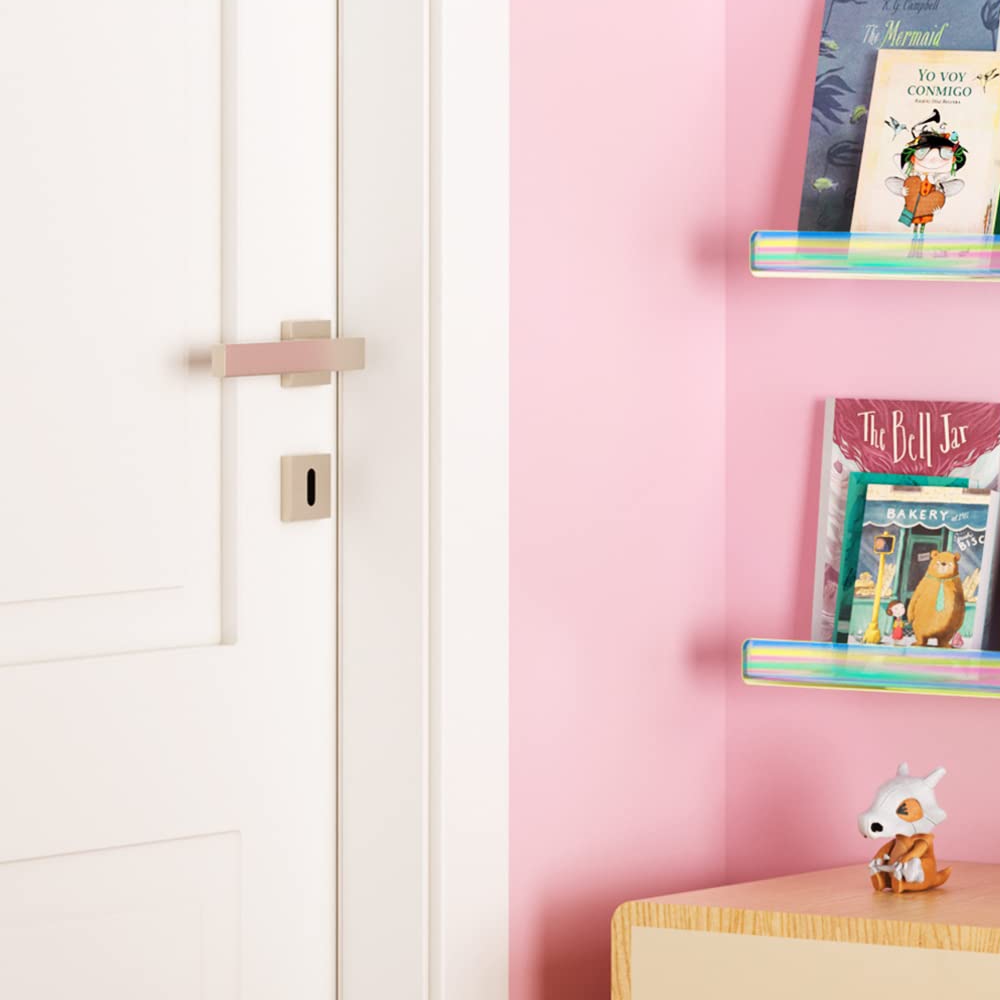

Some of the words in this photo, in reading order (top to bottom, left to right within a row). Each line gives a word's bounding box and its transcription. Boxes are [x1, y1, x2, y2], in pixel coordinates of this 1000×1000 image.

[863, 23, 879, 45] The
[880, 20, 949, 49] Mermaid
[918, 68, 935, 81] YO
[940, 71, 966, 82] VOY
[907, 85, 972, 97] CONMIGO
[857, 411, 886, 451] The
[892, 409, 932, 467] Bell
[939, 413, 968, 453] Jar
[887, 508, 949, 521] BAKERY
